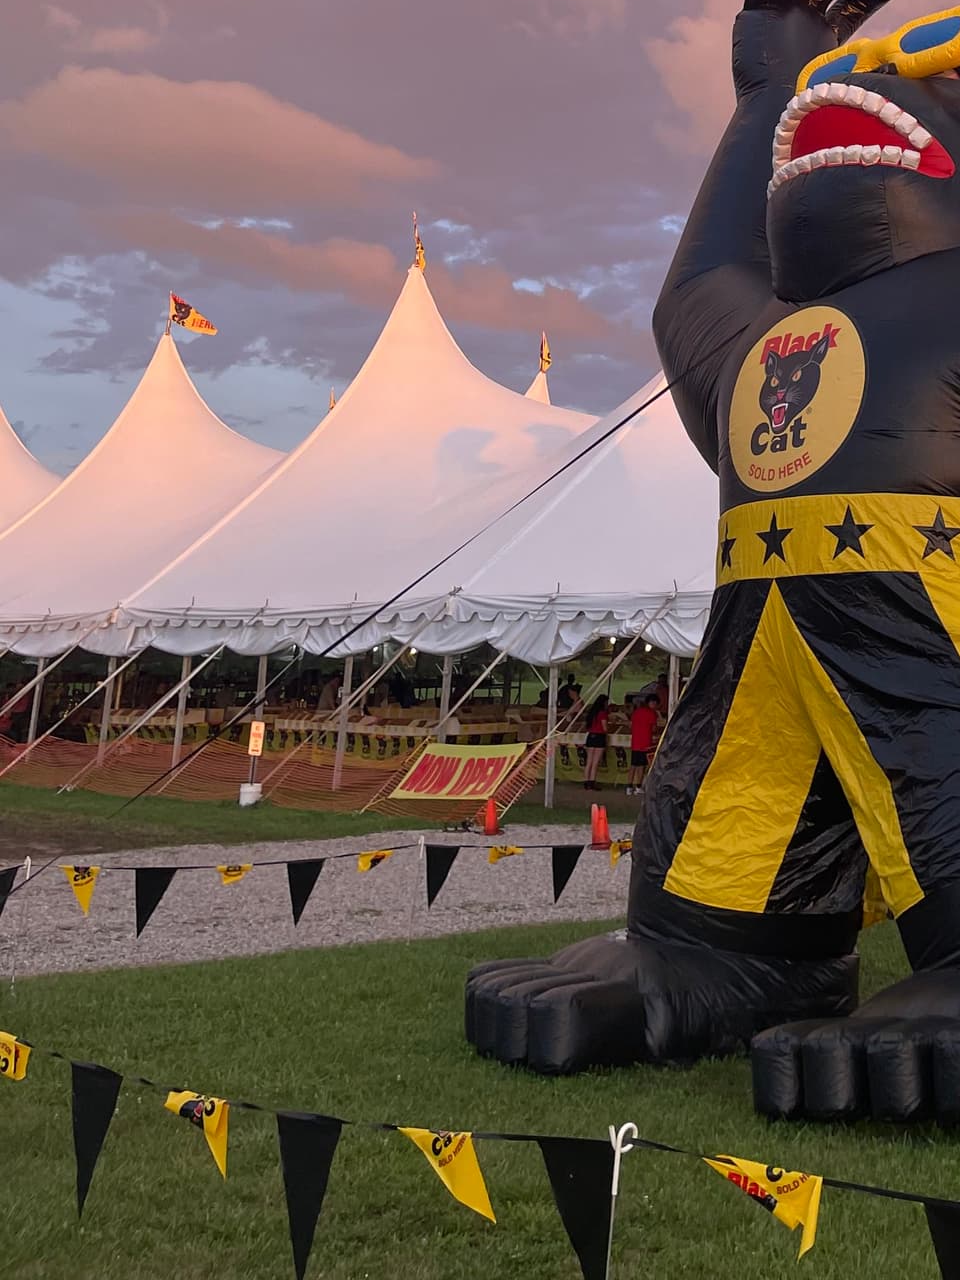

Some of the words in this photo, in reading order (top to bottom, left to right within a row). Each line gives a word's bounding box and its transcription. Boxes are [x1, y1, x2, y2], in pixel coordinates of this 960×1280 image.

[760, 323, 841, 365] Black
[751, 416, 807, 456] Cat
[748, 463, 775, 481] SOLD
[778, 452, 813, 479] HERE
[400, 753, 462, 795] NOW
[776, 1180, 800, 1195] SOLD
